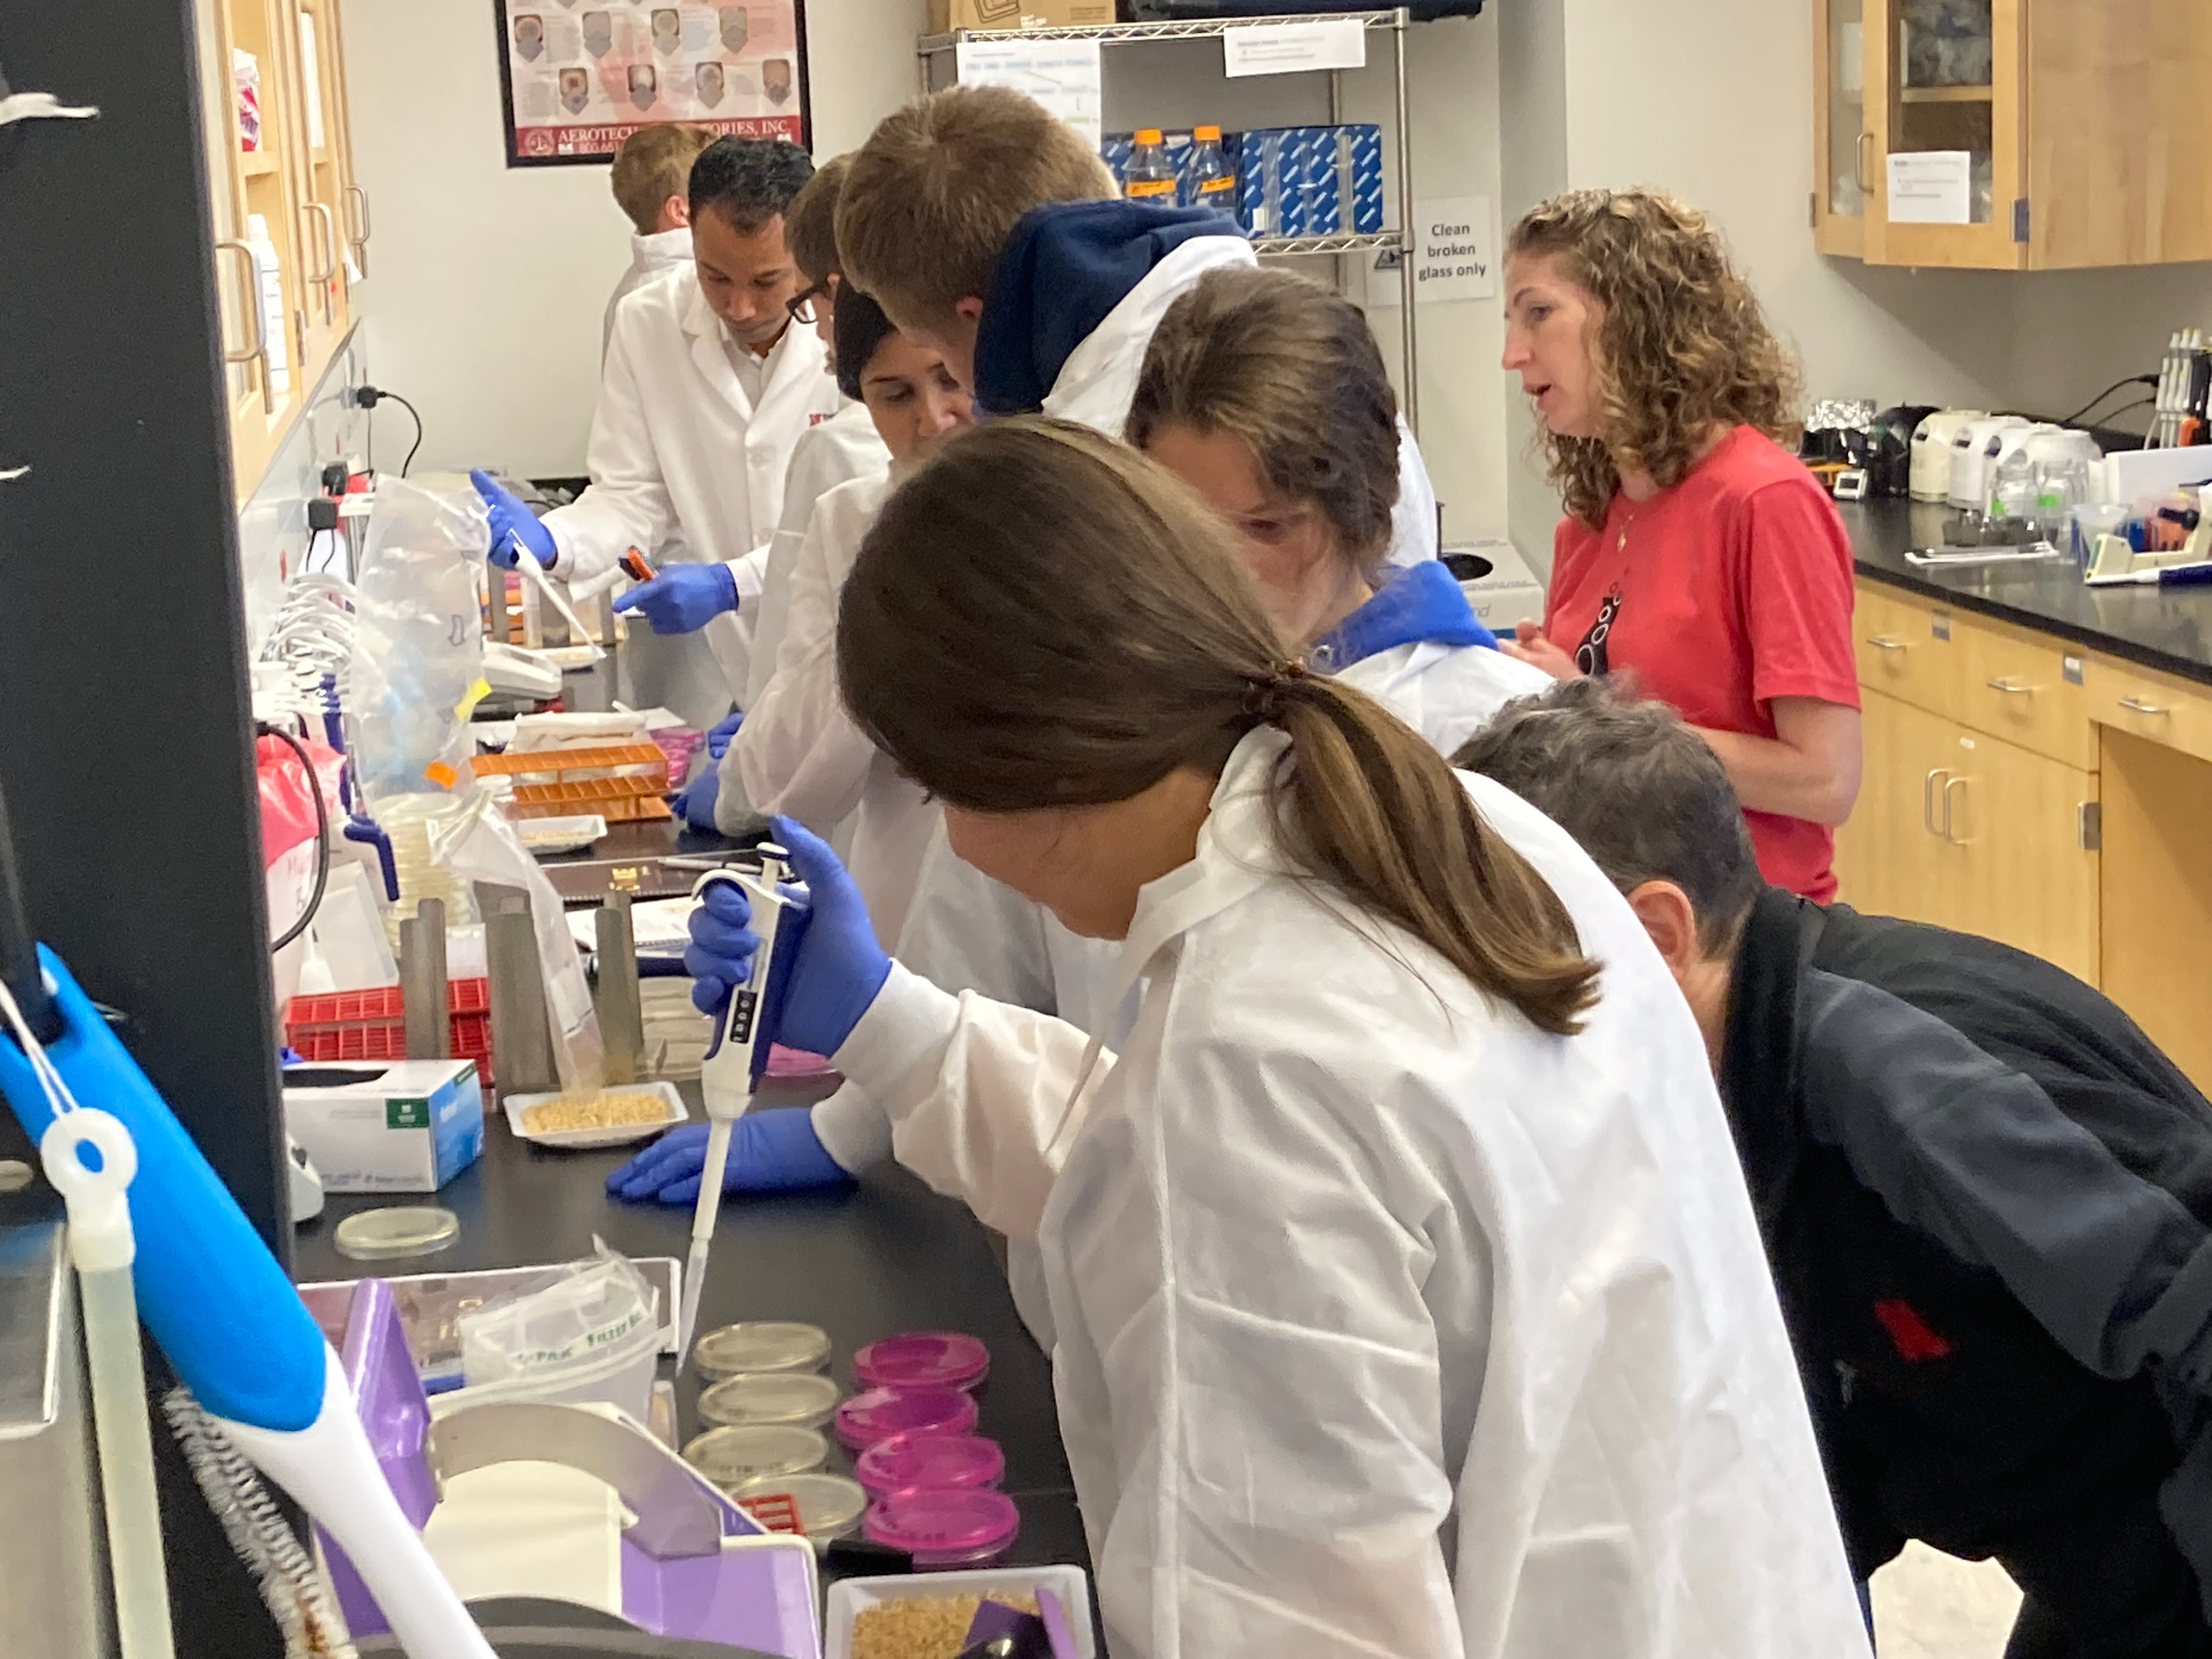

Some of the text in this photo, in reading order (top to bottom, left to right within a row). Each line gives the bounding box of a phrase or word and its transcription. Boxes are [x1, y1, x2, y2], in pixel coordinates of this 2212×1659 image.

[1431, 224, 1470, 236] Clean
[1427, 242, 1476, 258] broken
[1419, 262, 1486, 281] glass only
